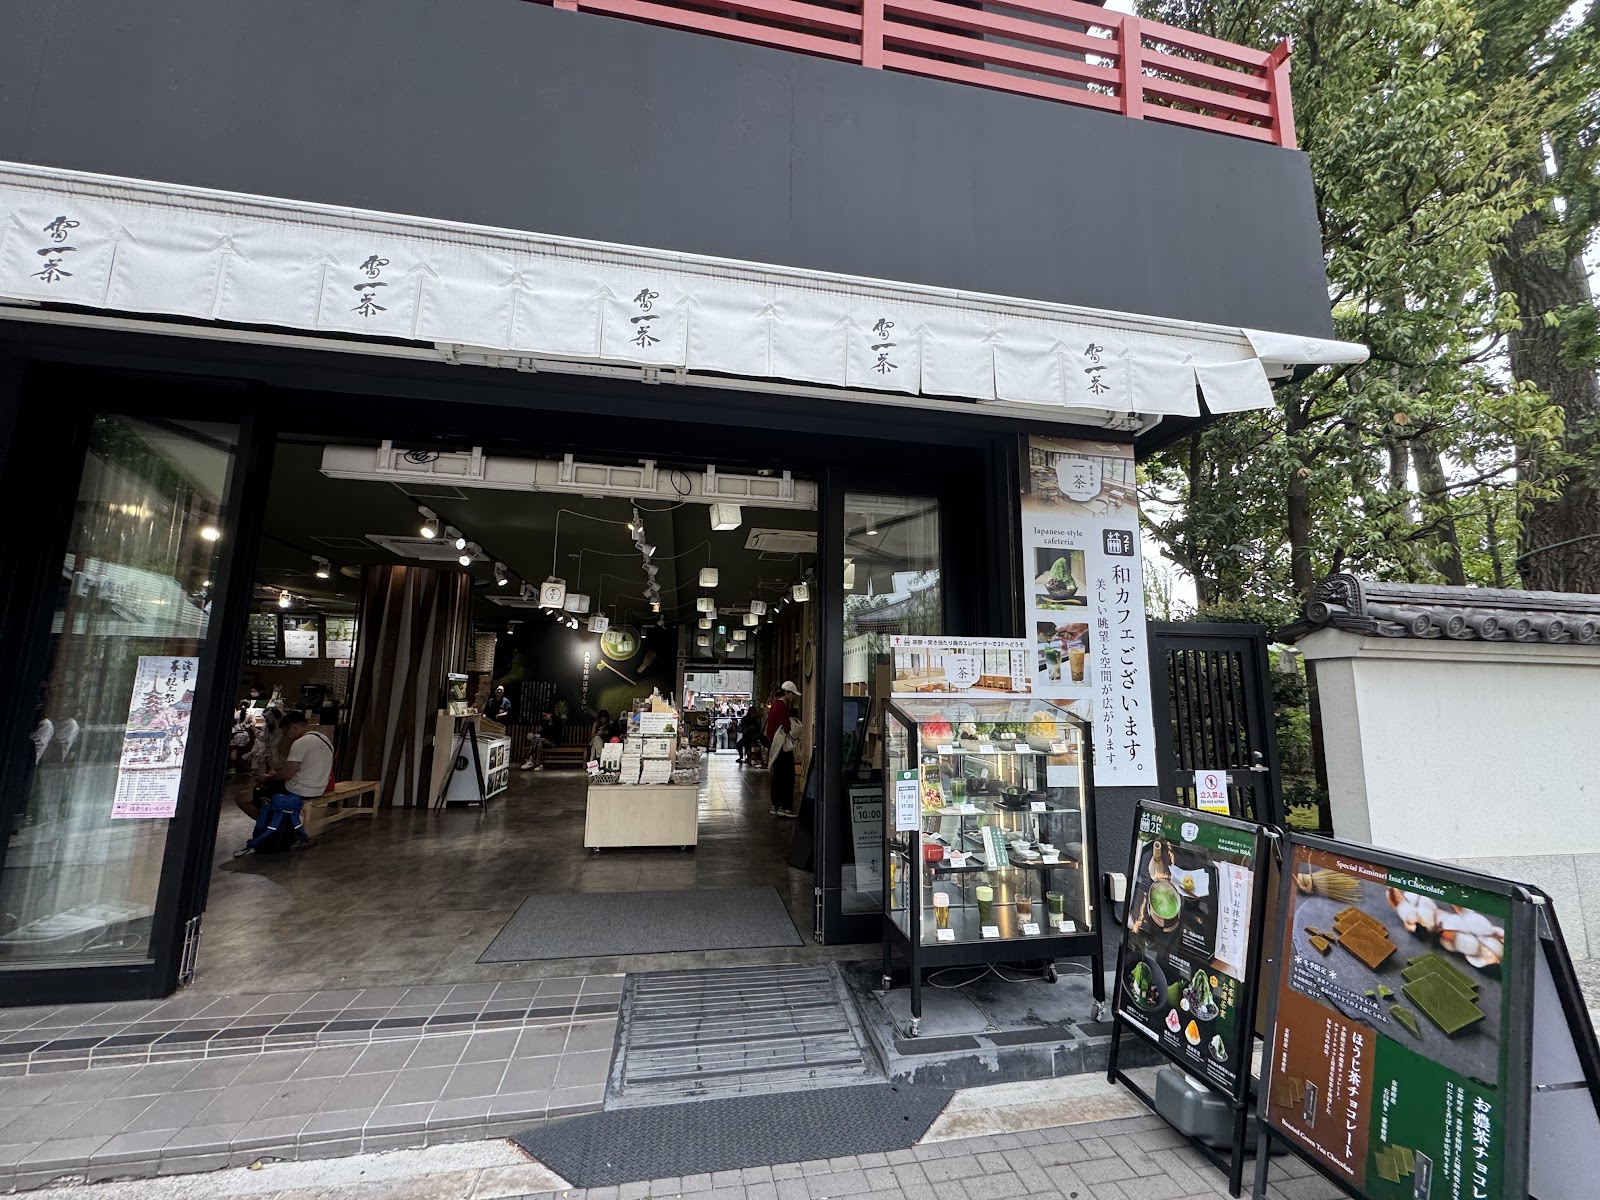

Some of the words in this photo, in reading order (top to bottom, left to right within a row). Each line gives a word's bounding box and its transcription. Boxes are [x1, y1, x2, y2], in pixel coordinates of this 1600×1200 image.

[1033, 527, 1082, 538] Japanese-style
[1043, 537, 1074, 546] cafeteria
[1123, 535, 1130, 552] 2F
[1095, 578, 1118, 772] 美しい眺望と空間が広がります。
[1112, 564, 1144, 772] 和カフェございます。
[858, 810, 881, 819] 10:00
[1150, 822, 1161, 834] 2F
[1336, 860, 1357, 872] Special
[1358, 866, 1387, 880] Kaminari
[1388, 874, 1407, 886] Issa's
[1407, 879, 1445, 896] Chocolate
[1303, 959, 1327, 975] 冬季限定
[1344, 1031, 1364, 1159] ほうじ茶チョコレート
[1472, 1096, 1492, 1199] お濃茶チョコレ
[1326, 1151, 1355, 1176] Chocolate
